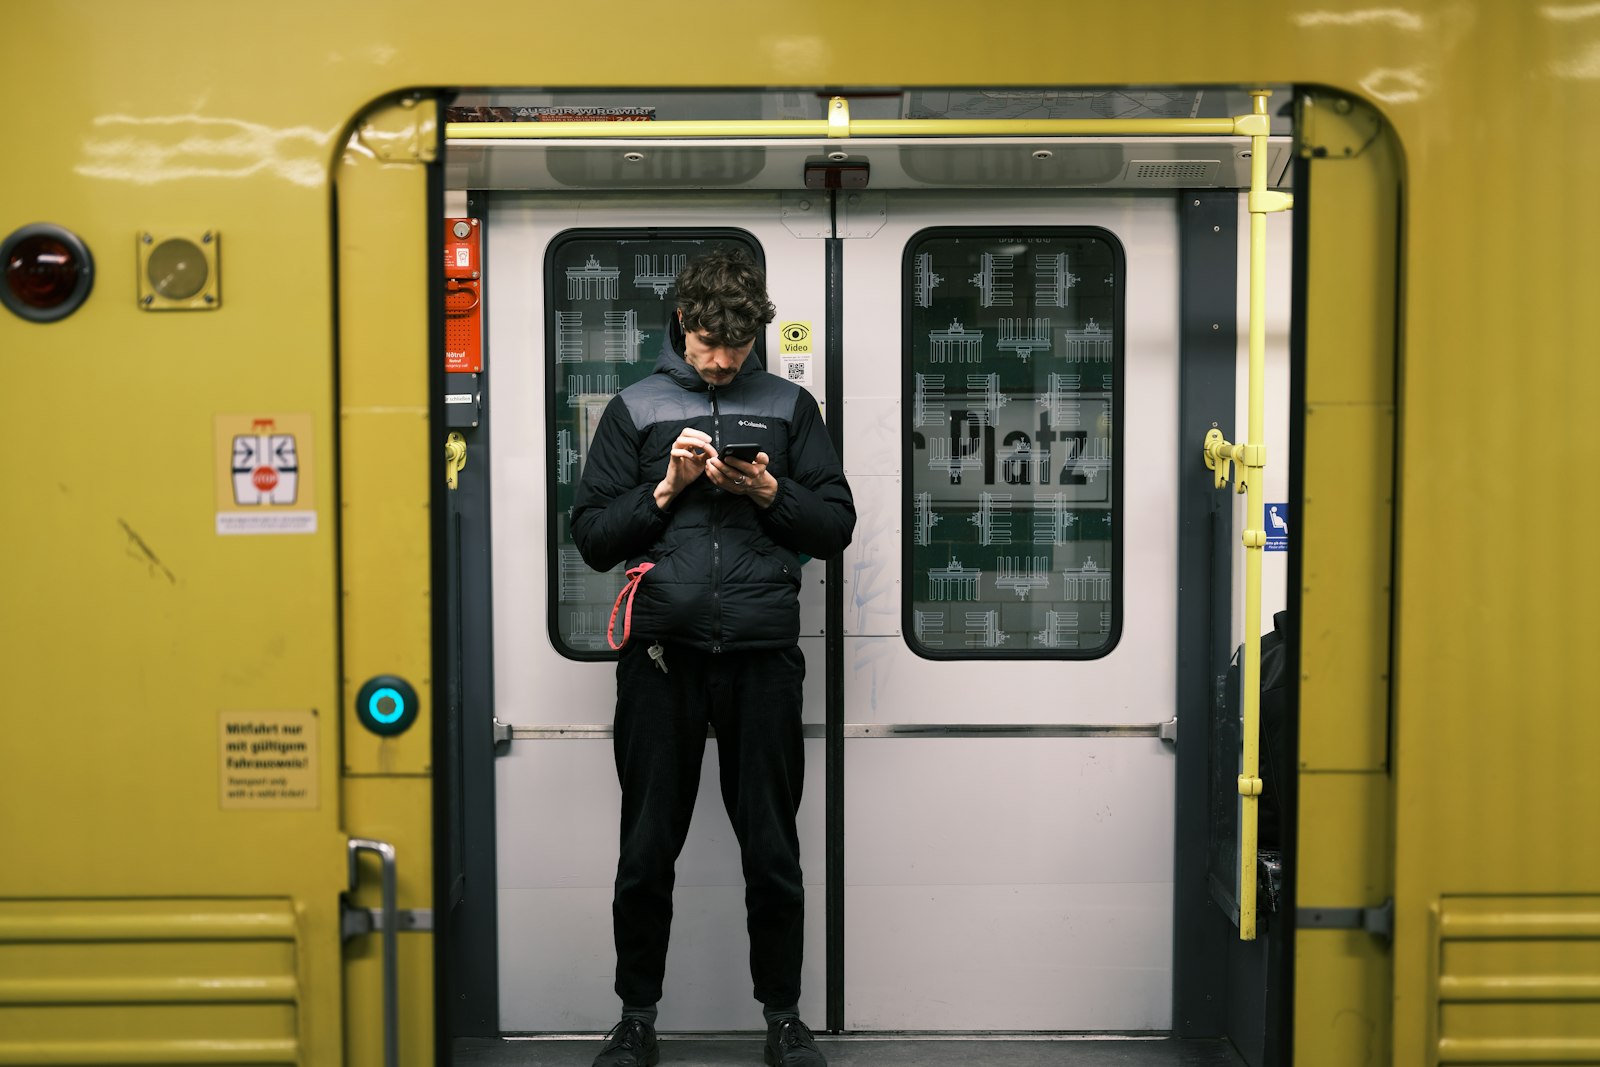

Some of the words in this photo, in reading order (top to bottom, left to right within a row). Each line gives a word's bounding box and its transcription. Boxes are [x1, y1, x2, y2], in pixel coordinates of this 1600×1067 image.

[550, 107, 573, 115] DIR
[785, 344, 808, 352] Video
[743, 420, 768, 430] Columbia
[950, 410, 1088, 485] Platz
[254, 473, 278, 484] STOP
[226, 723, 278, 735] Mitfahrt
[282, 725, 303, 735] nur
[226, 740, 248, 752] mit
